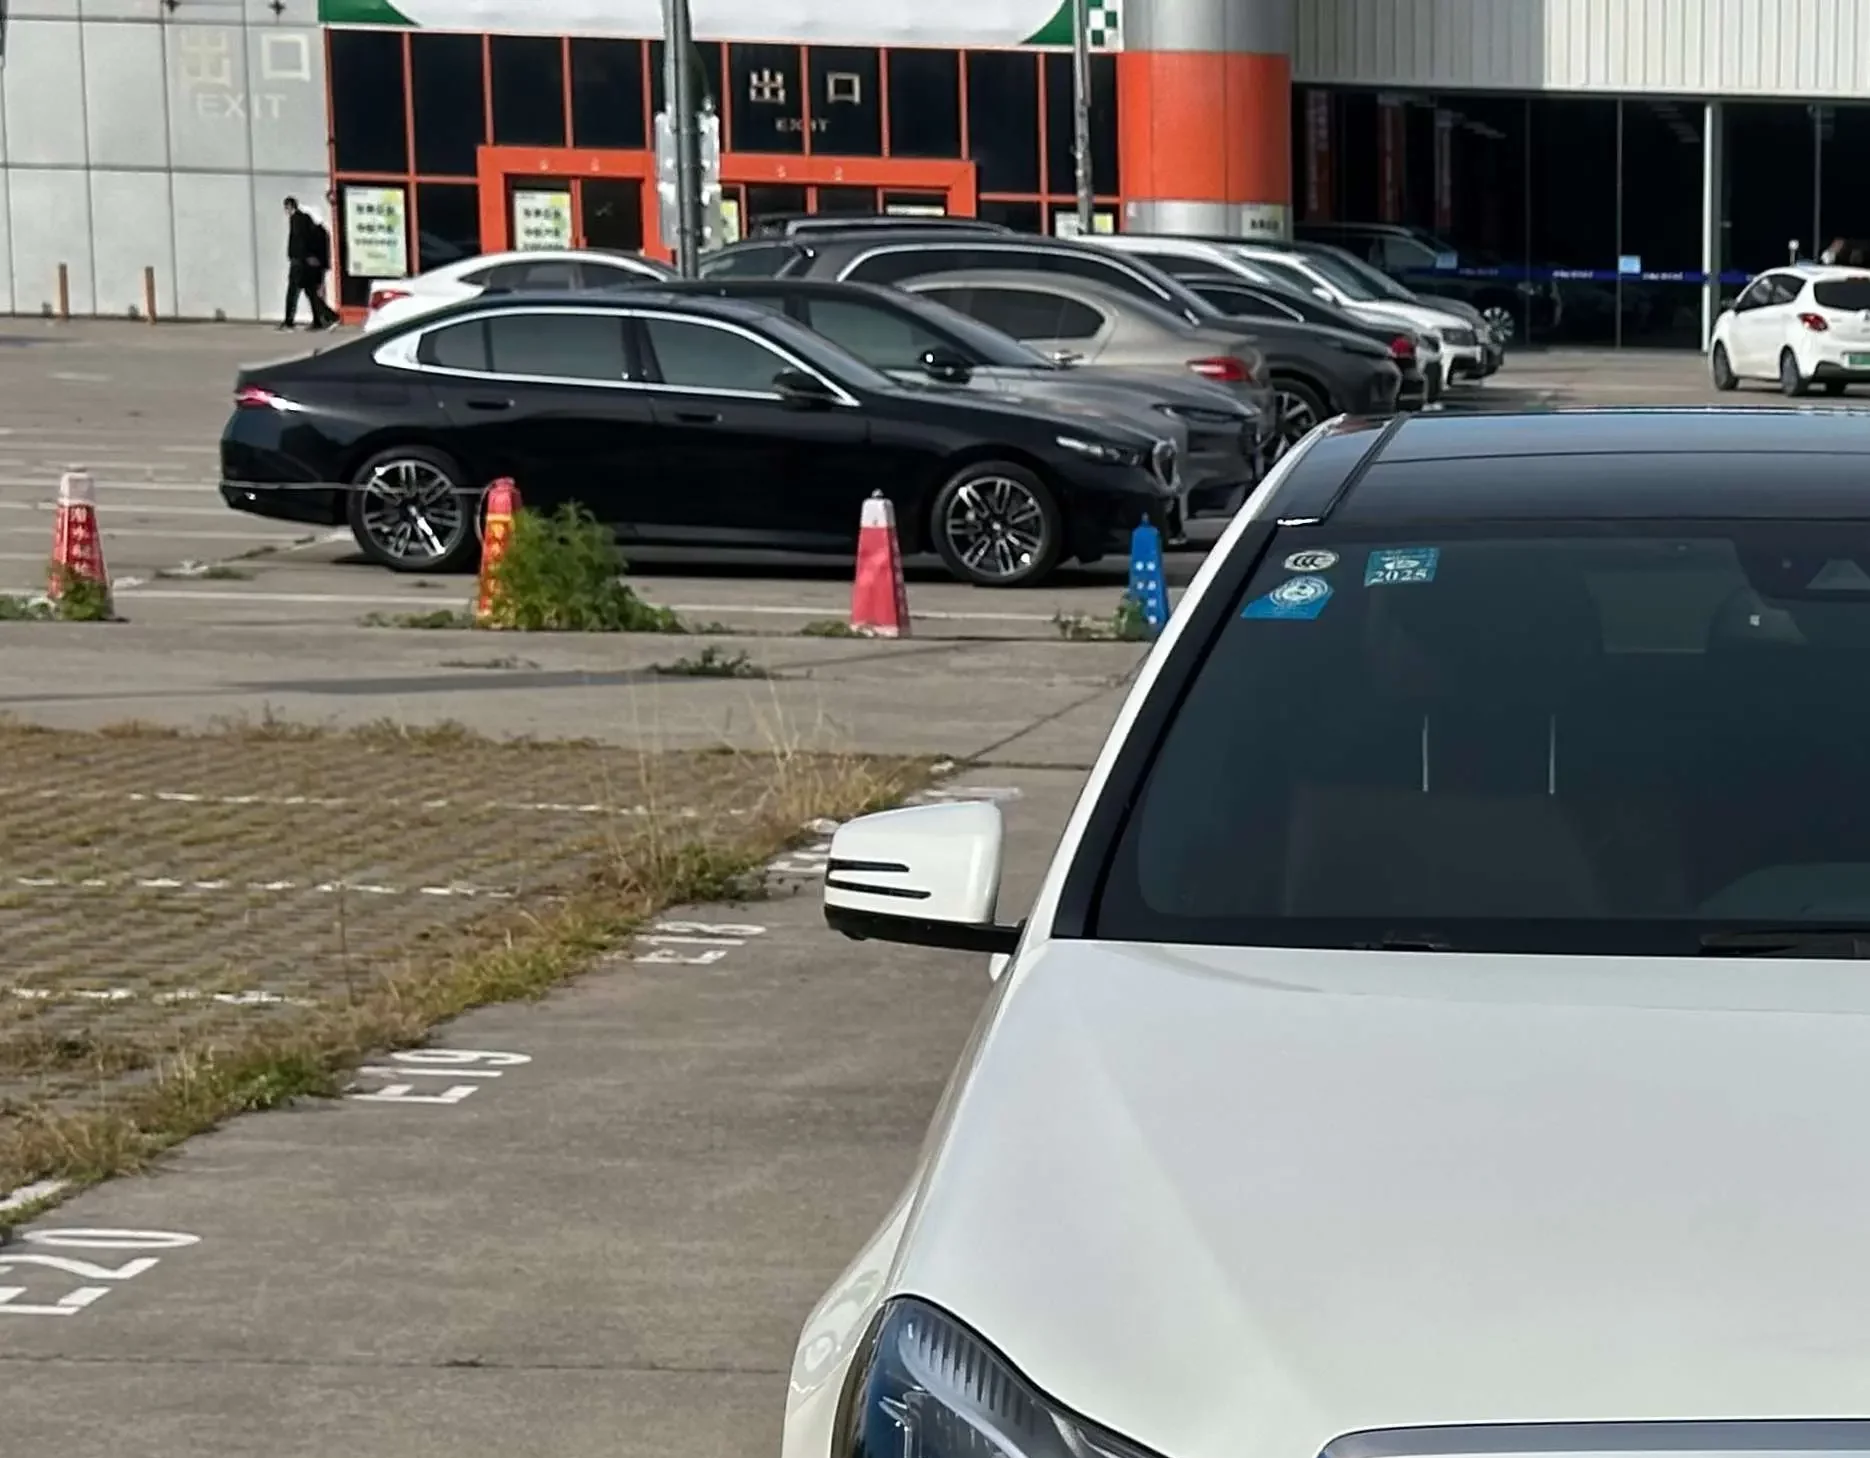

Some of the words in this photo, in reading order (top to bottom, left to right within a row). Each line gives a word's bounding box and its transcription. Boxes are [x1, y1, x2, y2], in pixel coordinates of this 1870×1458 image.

[749, 67, 861, 105] 出口
[196, 92, 287, 119] EXIT
[1370, 568, 1429, 584] 2025
